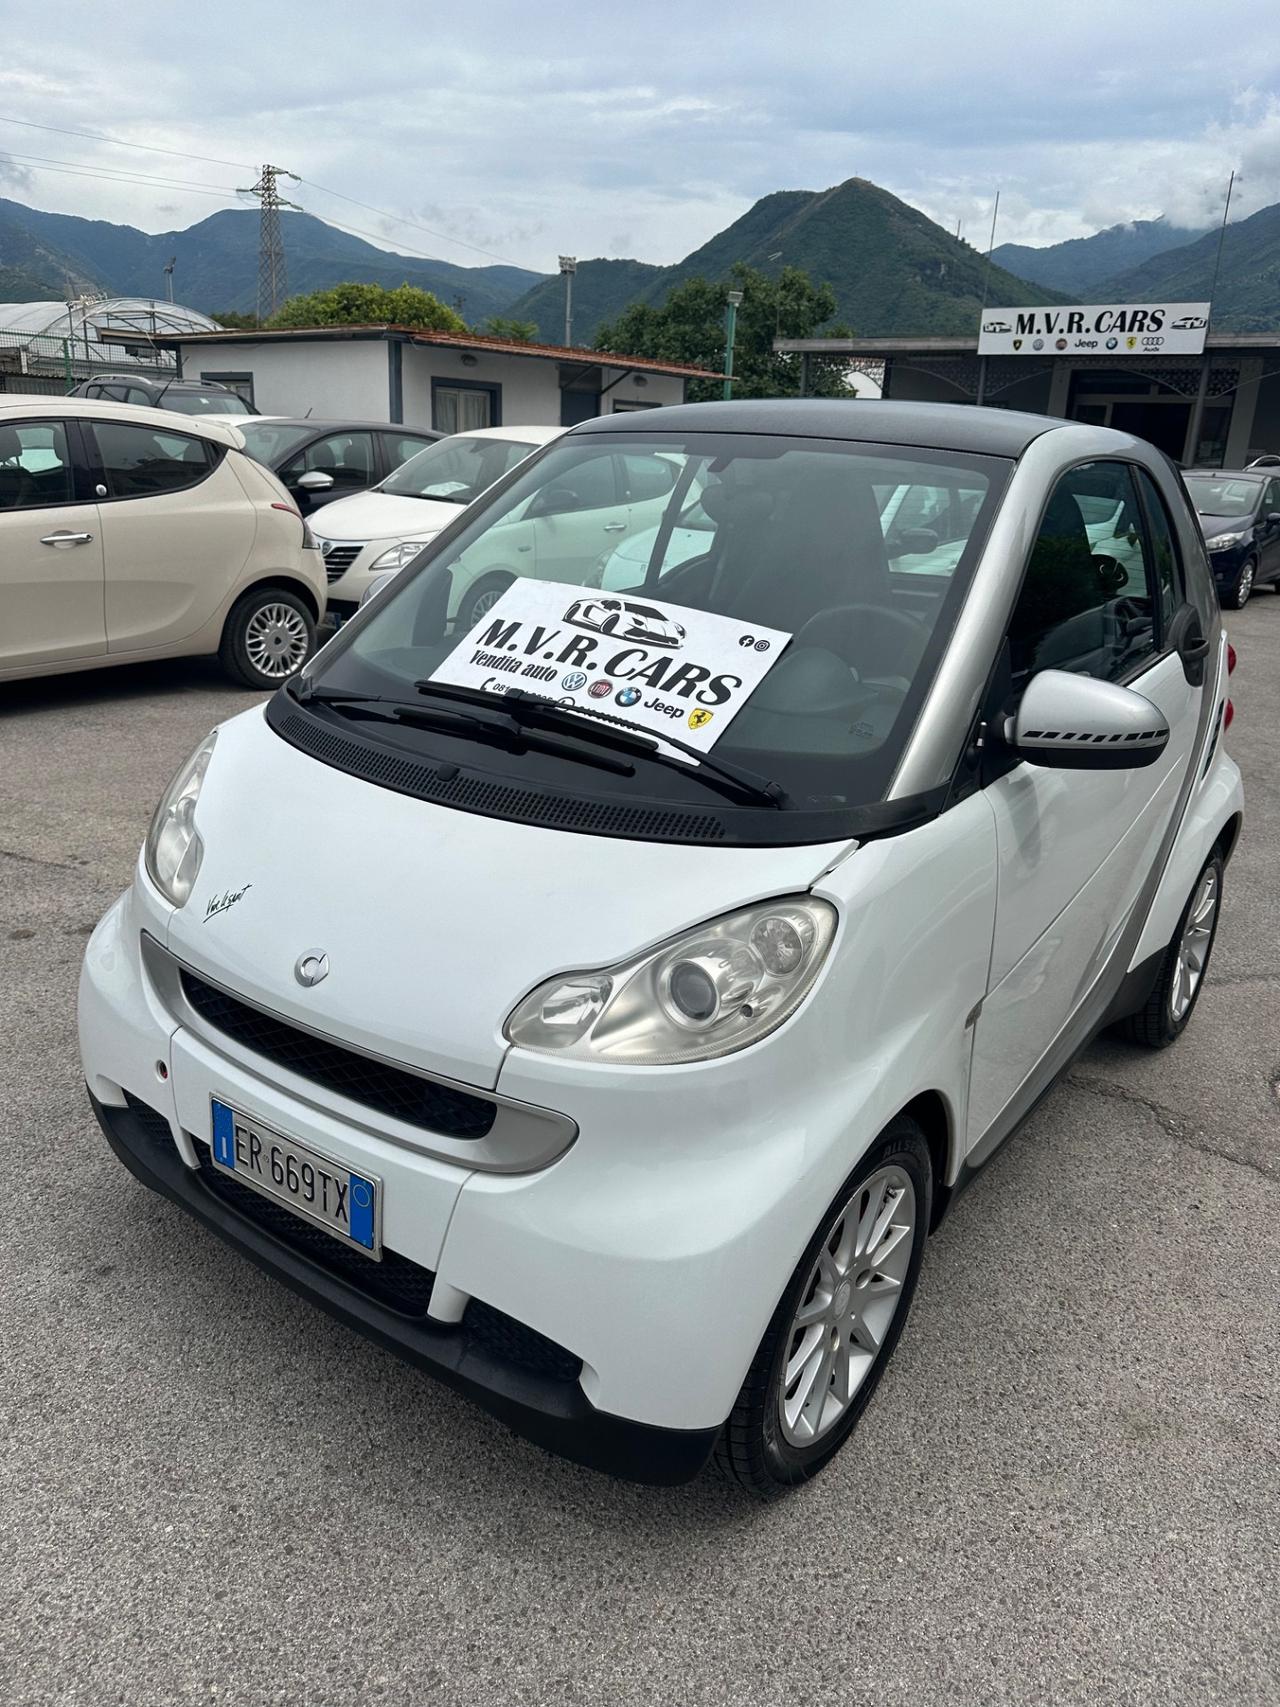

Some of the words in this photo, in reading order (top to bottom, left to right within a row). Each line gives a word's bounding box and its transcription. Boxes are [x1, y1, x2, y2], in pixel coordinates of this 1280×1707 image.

[1074, 338, 1098, 350] Jeep
[469, 649, 522, 674] Vendita
[520, 663, 558, 682] auto
[644, 697, 685, 719] Jeep
